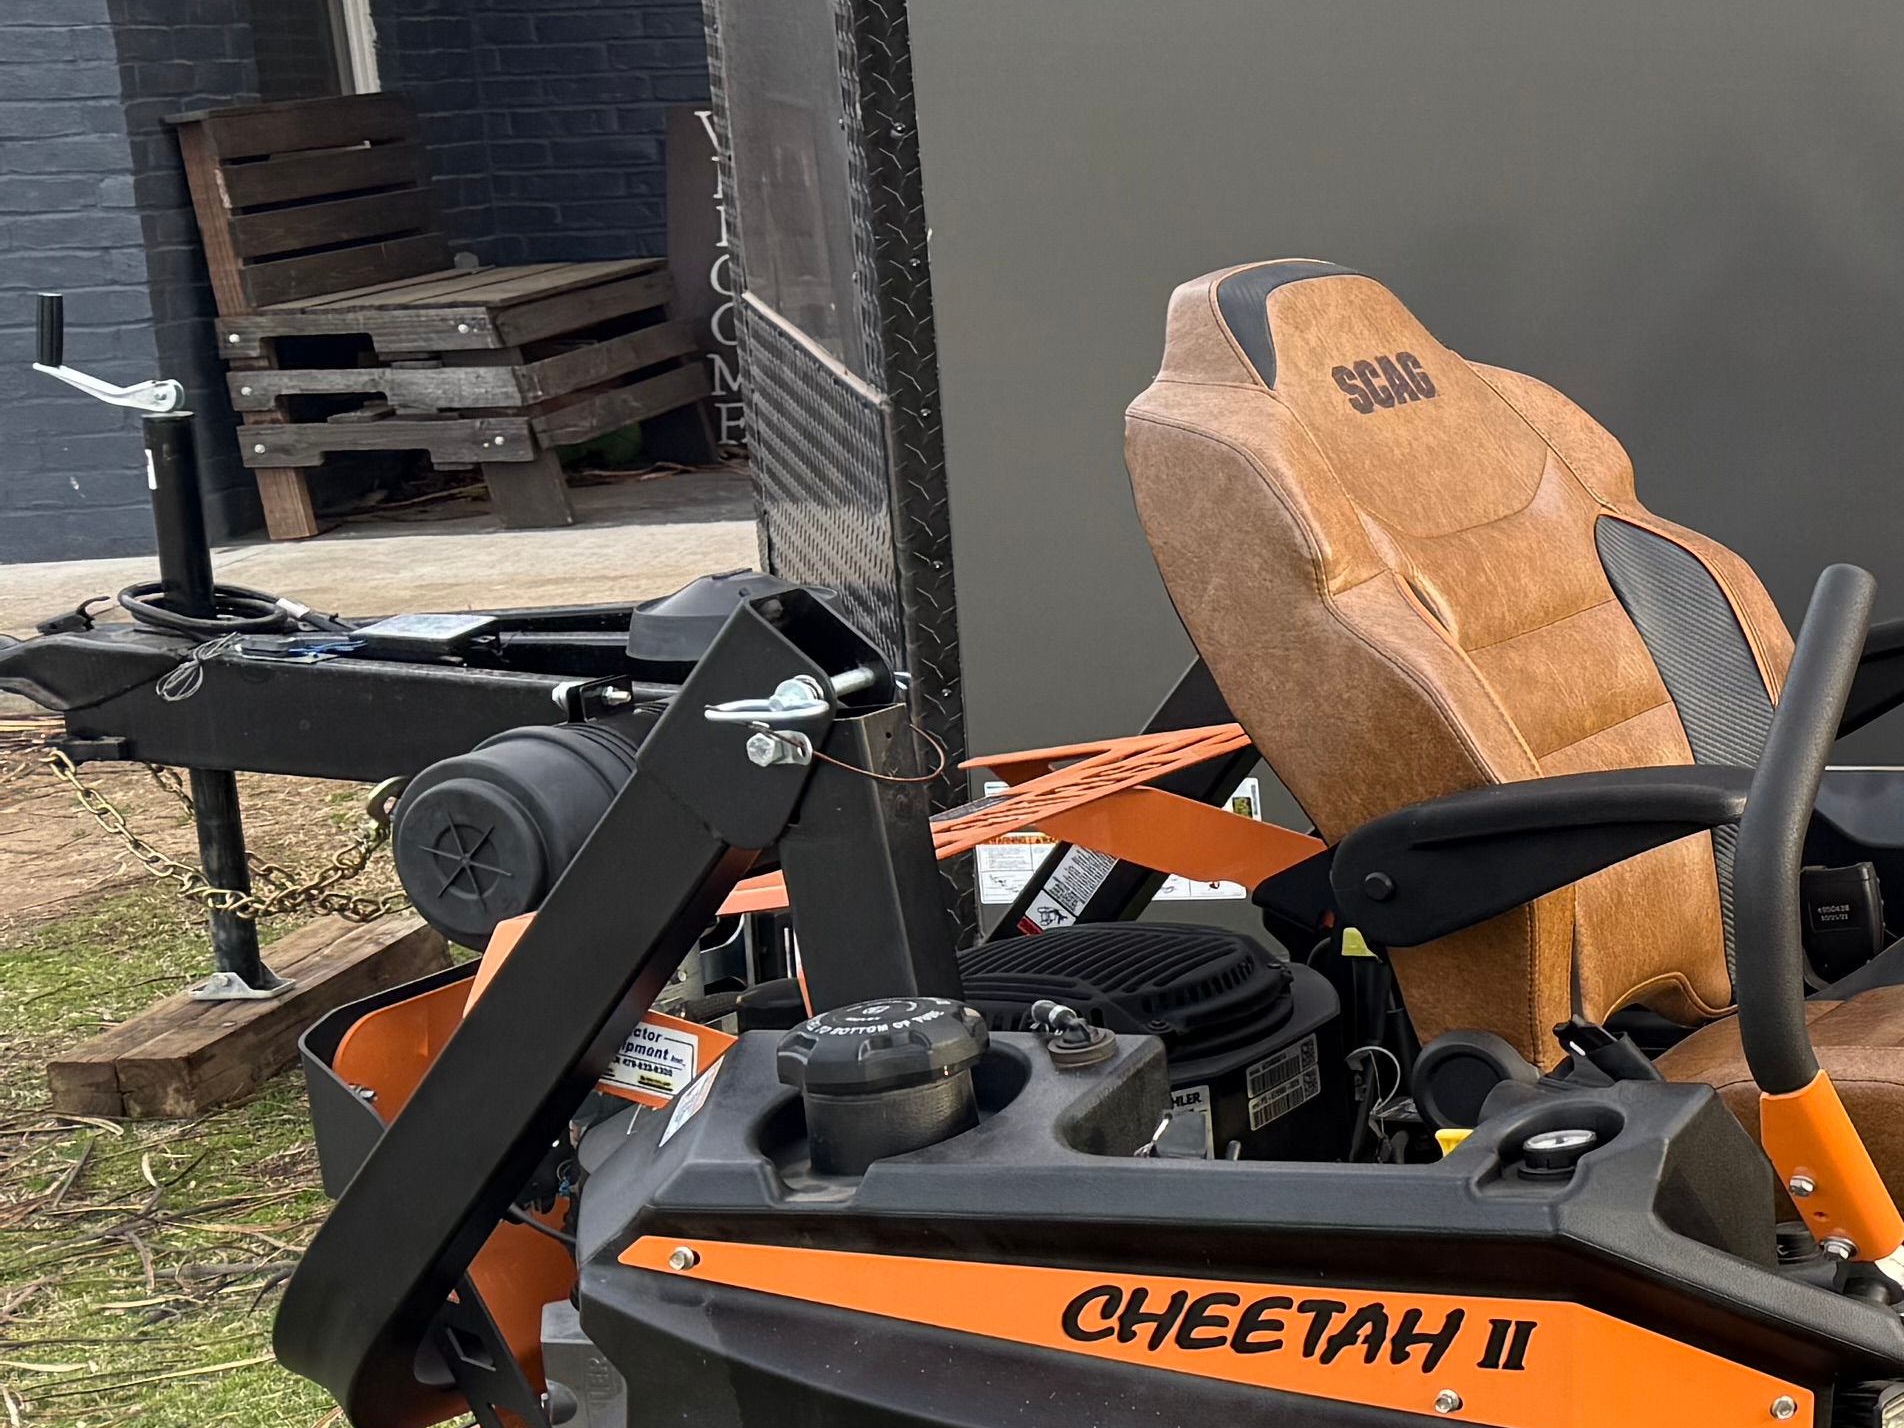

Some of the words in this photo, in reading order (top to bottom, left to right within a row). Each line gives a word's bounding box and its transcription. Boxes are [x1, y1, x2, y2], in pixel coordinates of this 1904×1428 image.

[1331, 351, 1436, 415] SCAG
[633, 1025, 663, 1044] ctor
[1172, 1091, 1202, 1108] HLER
[1061, 1283, 1466, 1375] CHEETAH
[1477, 1318, 1538, 1372] II
